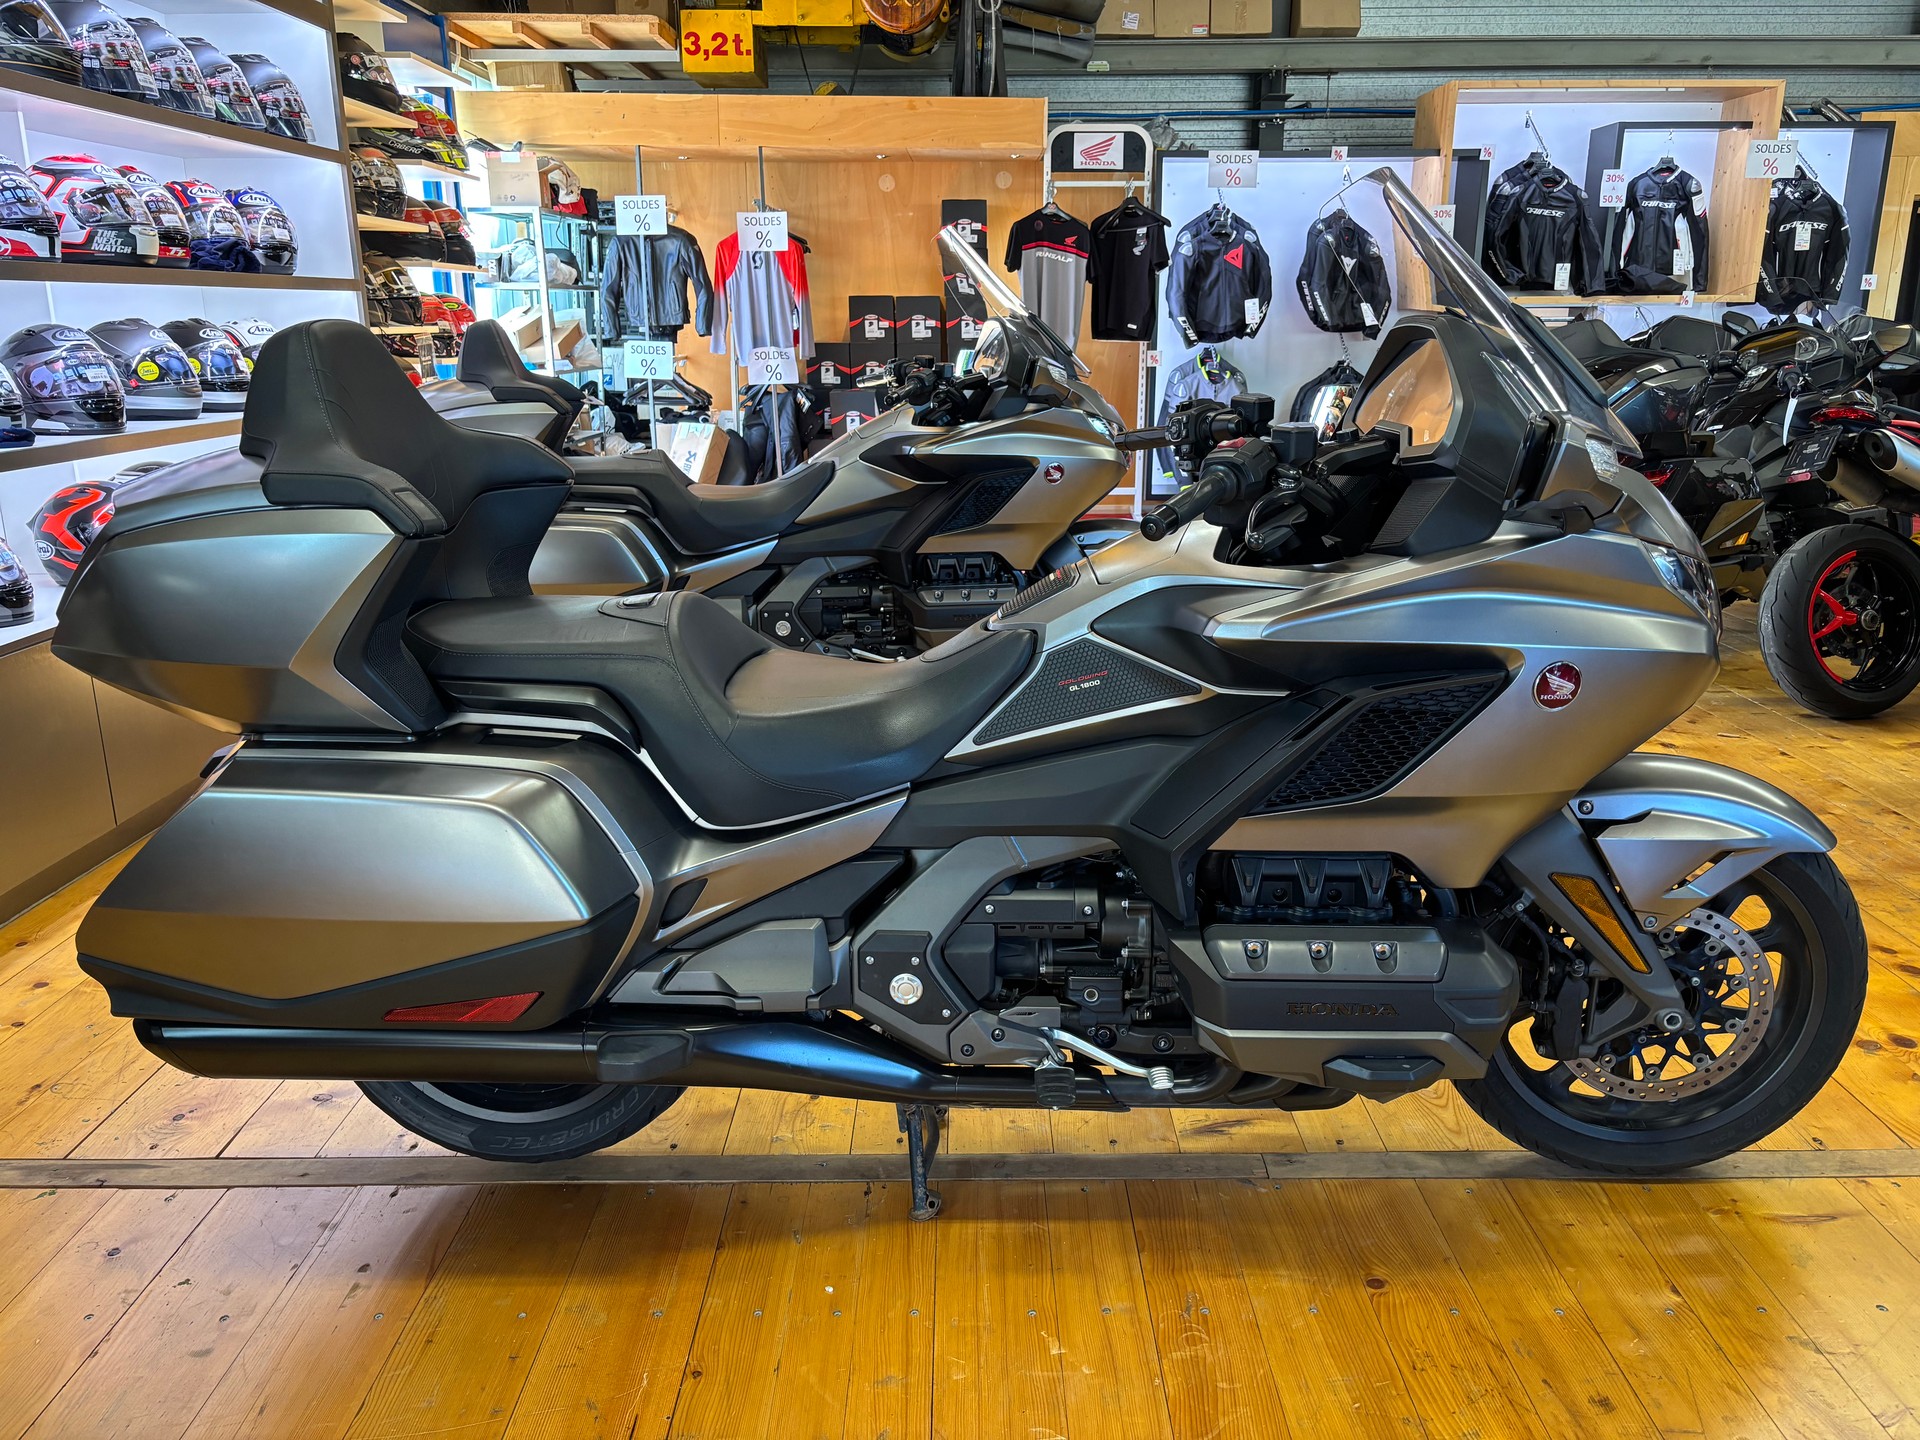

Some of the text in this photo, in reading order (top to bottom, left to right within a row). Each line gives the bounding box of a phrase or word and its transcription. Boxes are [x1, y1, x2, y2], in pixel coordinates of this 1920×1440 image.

[388, 139, 422, 154] CABERG
[1755, 143, 1792, 154] SOLDES
[1334, 150, 1343, 161] %
[1483, 147, 1492, 158] %
[1216, 154, 1253, 165] SOLDES
[1763, 157, 1779, 176] %
[1226, 168, 1242, 186] %
[1606, 174, 1625, 183] 30%
[1603, 195, 1624, 203] 50 %
[622, 200, 660, 210] SOLDES
[1433, 209, 1452, 218] 30%
[634, 213, 651, 232] %
[744, 216, 782, 227] SOLDES
[97, 229, 118, 237] THE
[94, 236, 123, 245] NEXT
[756, 230, 772, 249] %
[91, 242, 132, 254] MATCH
[1864, 278, 1873, 288] %
[630, 345, 667, 356] SOLDES
[754, 350, 790, 361] SOLDES
[1150, 355, 1159, 364] %
[641, 358, 657, 376] %
[765, 363, 782, 382] %
[1058, 670, 1108, 687] GOLDWING
[1069, 680, 1101, 692] GL1800
[1286, 1002, 1400, 1016] HONDA
